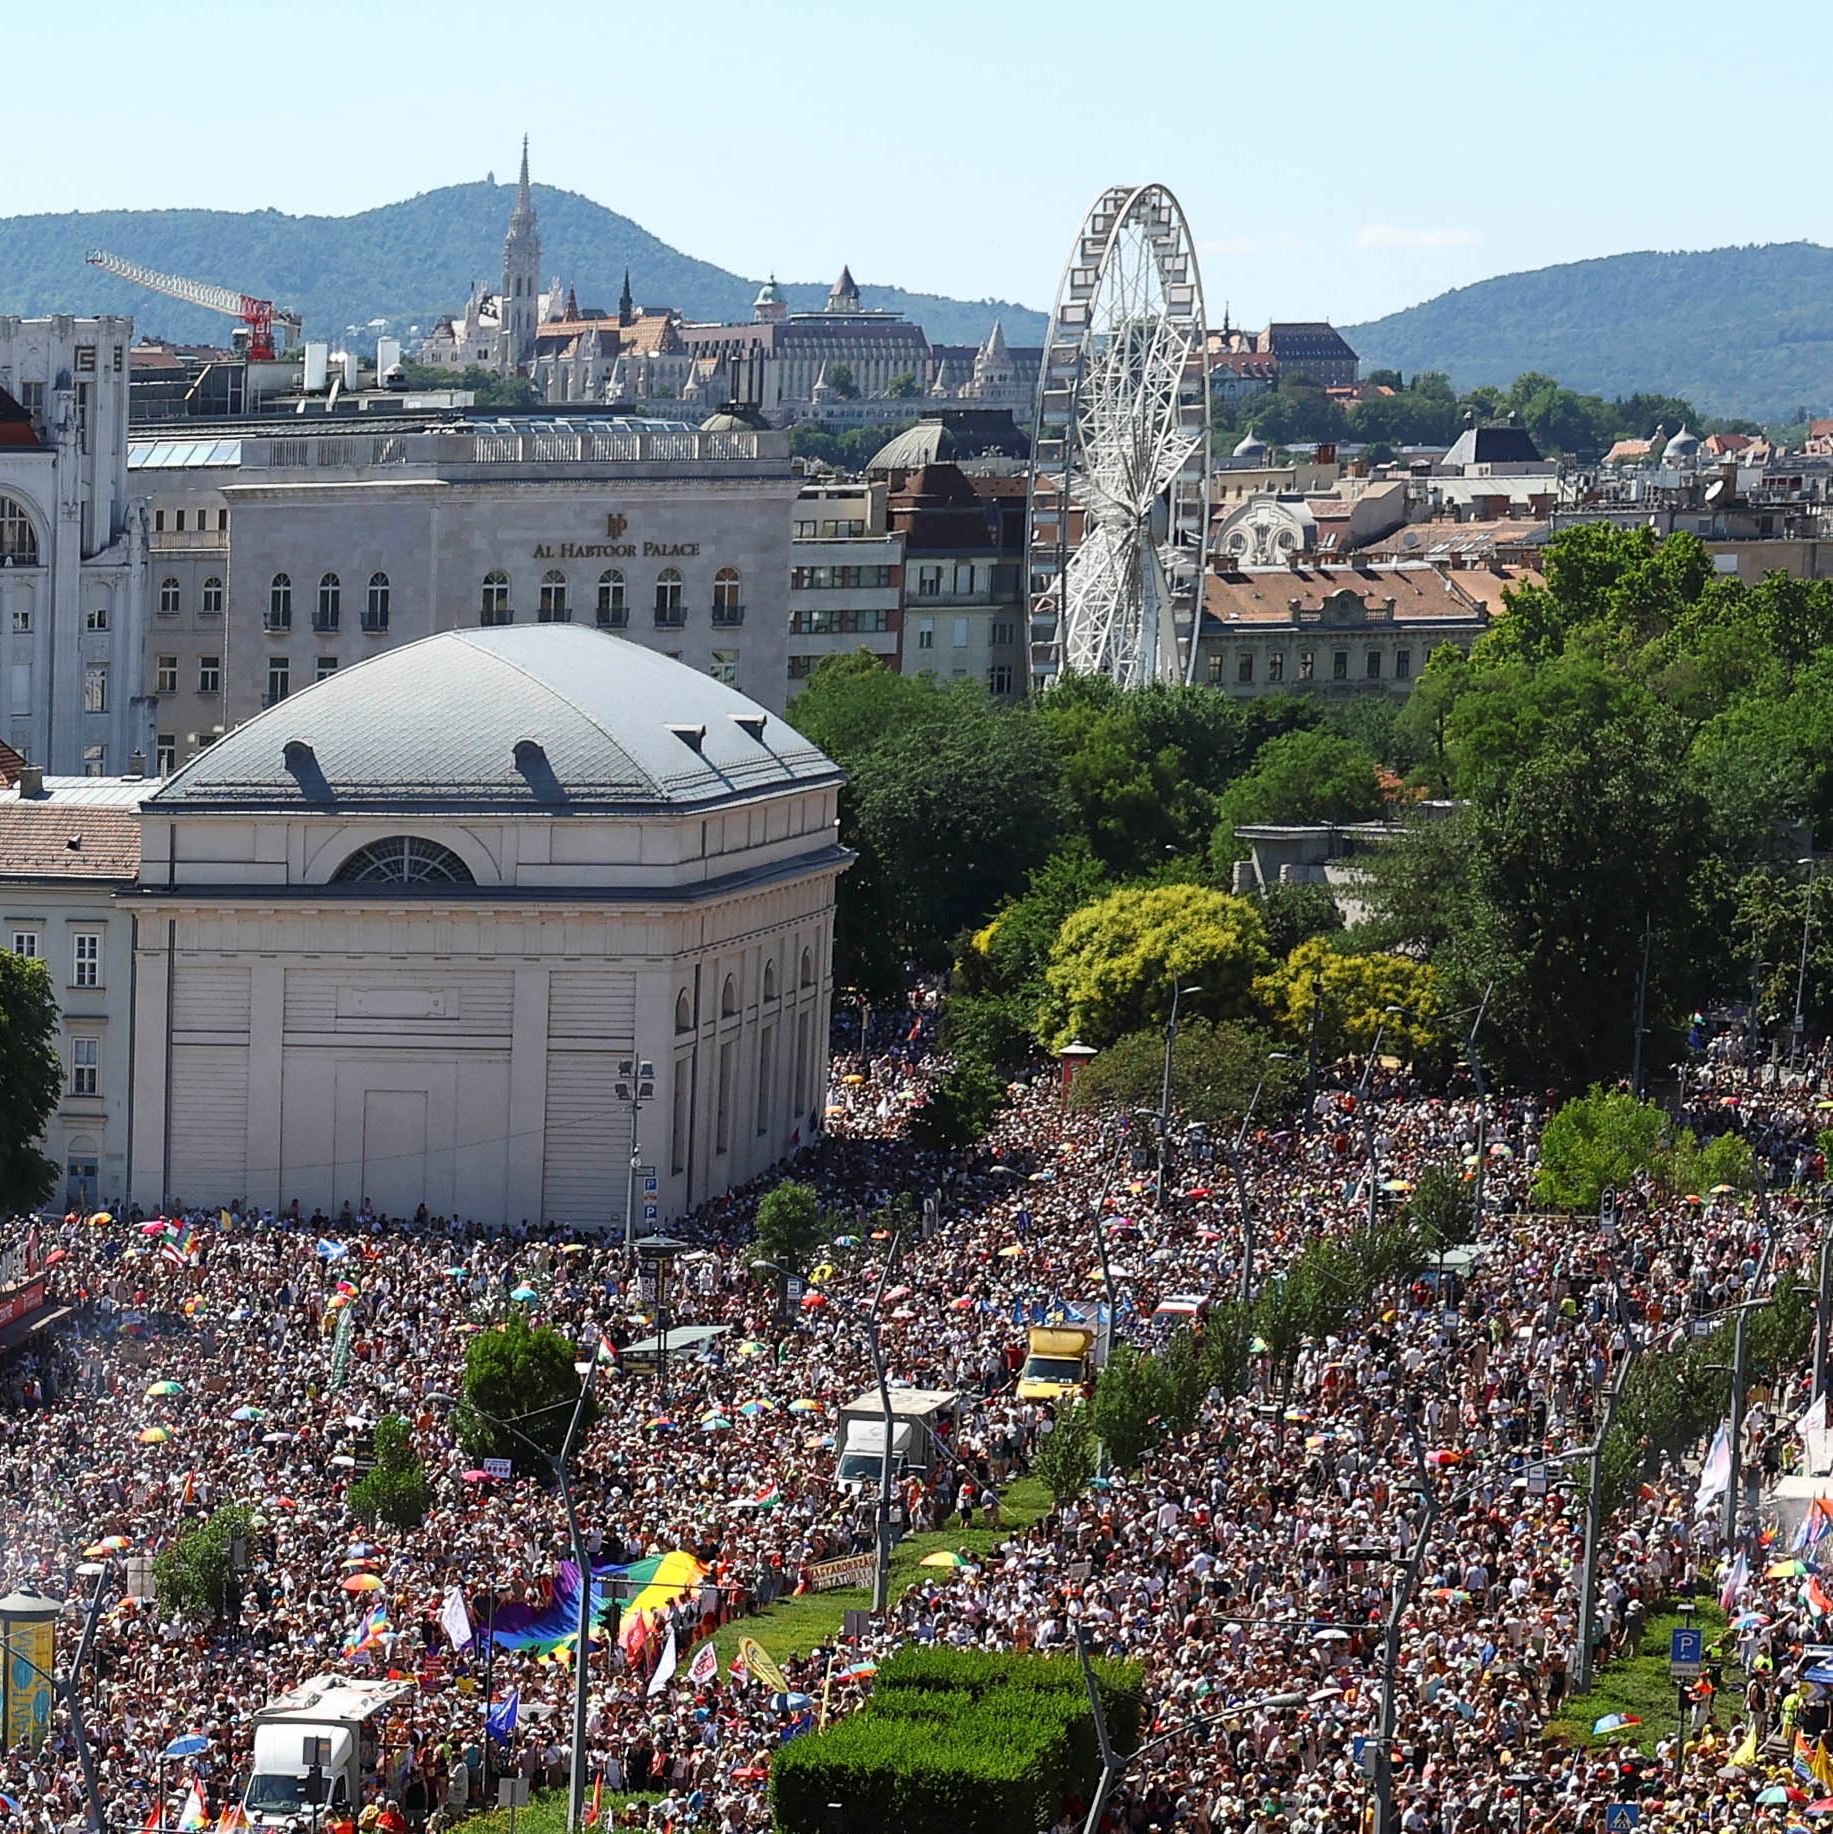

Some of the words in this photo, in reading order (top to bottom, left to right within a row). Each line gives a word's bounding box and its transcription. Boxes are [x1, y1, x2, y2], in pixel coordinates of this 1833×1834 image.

[533, 544, 554, 558] AL
[560, 543, 637, 558] HABTOOR
[643, 542, 700, 556] PALACE
[1681, 1637, 1693, 1652] P
